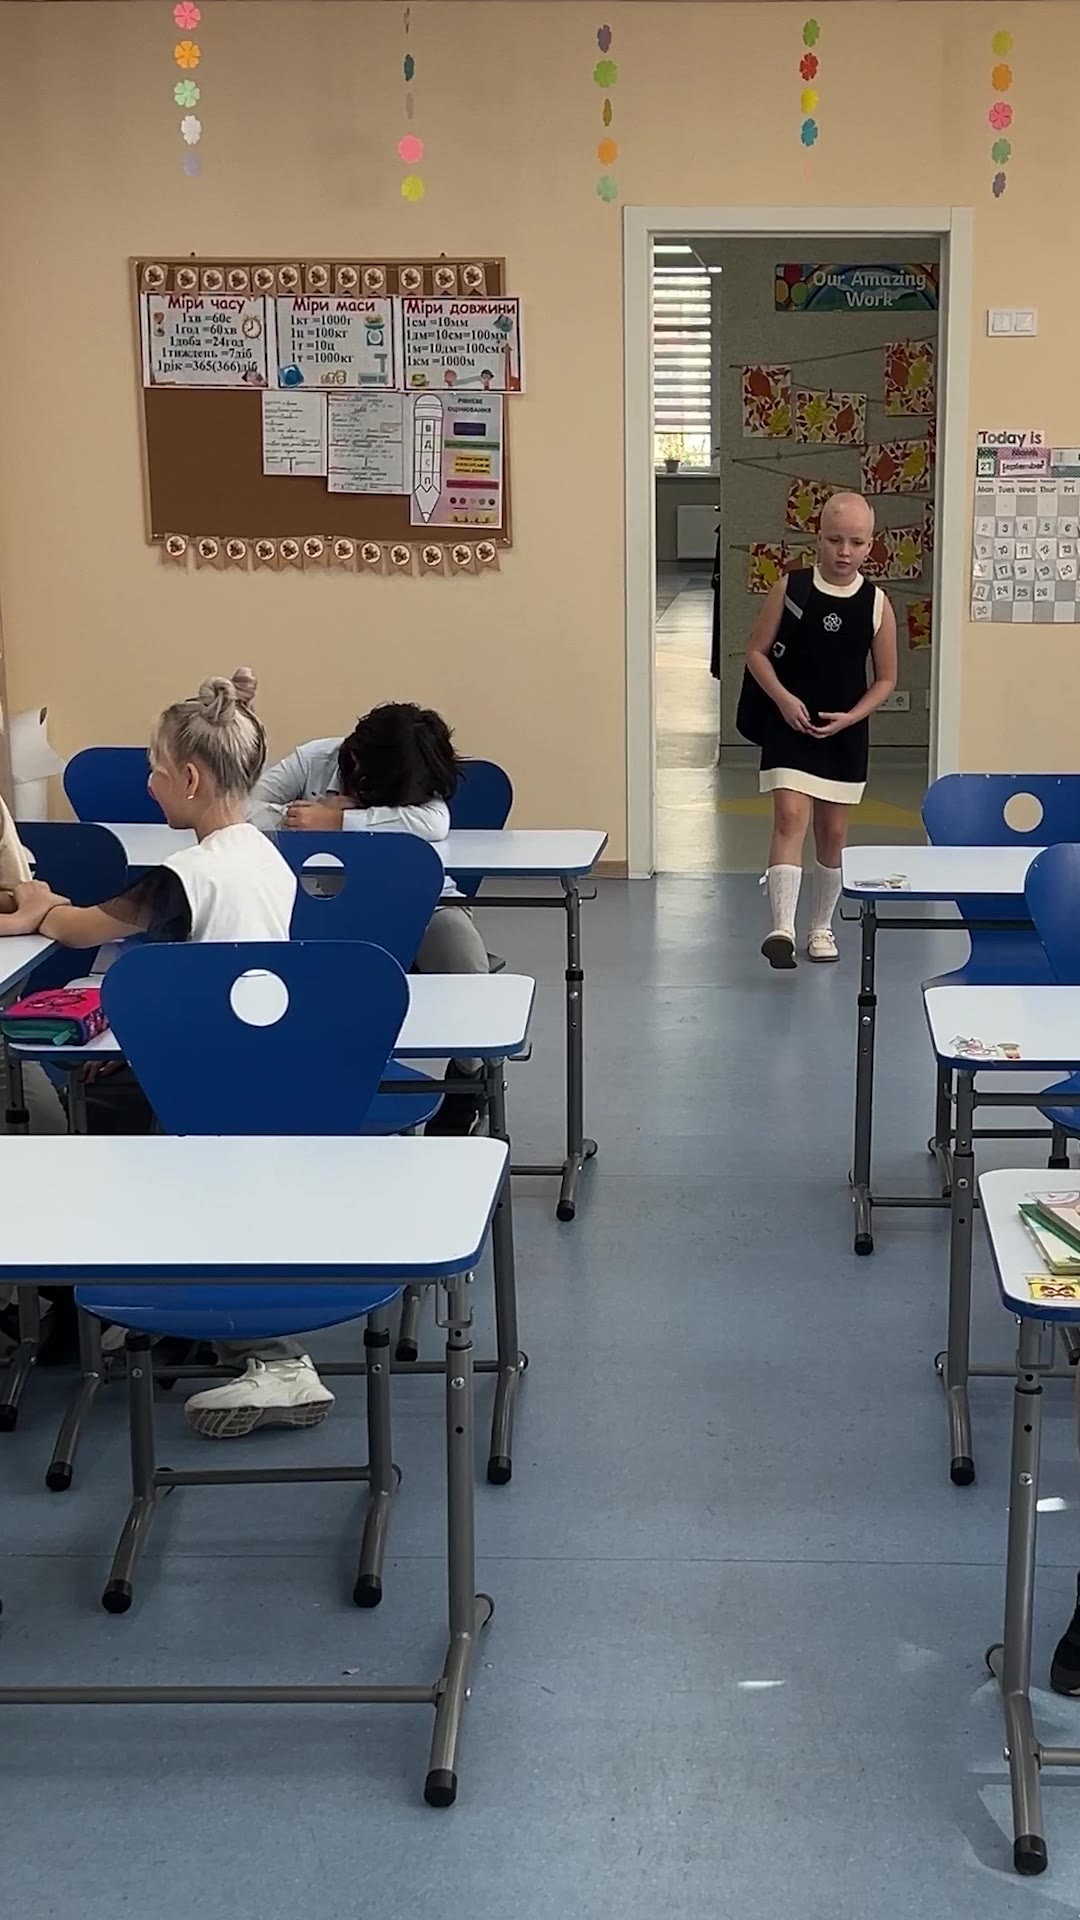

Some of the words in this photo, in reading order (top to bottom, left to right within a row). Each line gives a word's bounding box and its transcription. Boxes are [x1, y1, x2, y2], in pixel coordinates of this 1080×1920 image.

[813, 271, 845, 286] Our
[852, 270, 926, 290] Amazing
[168, 296, 204, 313] Міри
[210, 299, 245, 314] часу
[293, 297, 329, 315] Міри
[336, 301, 375, 312] маси
[846, 291, 893, 307] Work
[406, 299, 443, 318] Міри
[450, 304, 515, 315] довжини
[978, 431, 1027, 448] Today
[1030, 431, 1042, 444] is
[1064, 485, 1075, 493] Fri
[1002, 524, 1008, 532] 3
[1044, 523, 1051, 531] 5
[1065, 524, 1072, 532] 6
